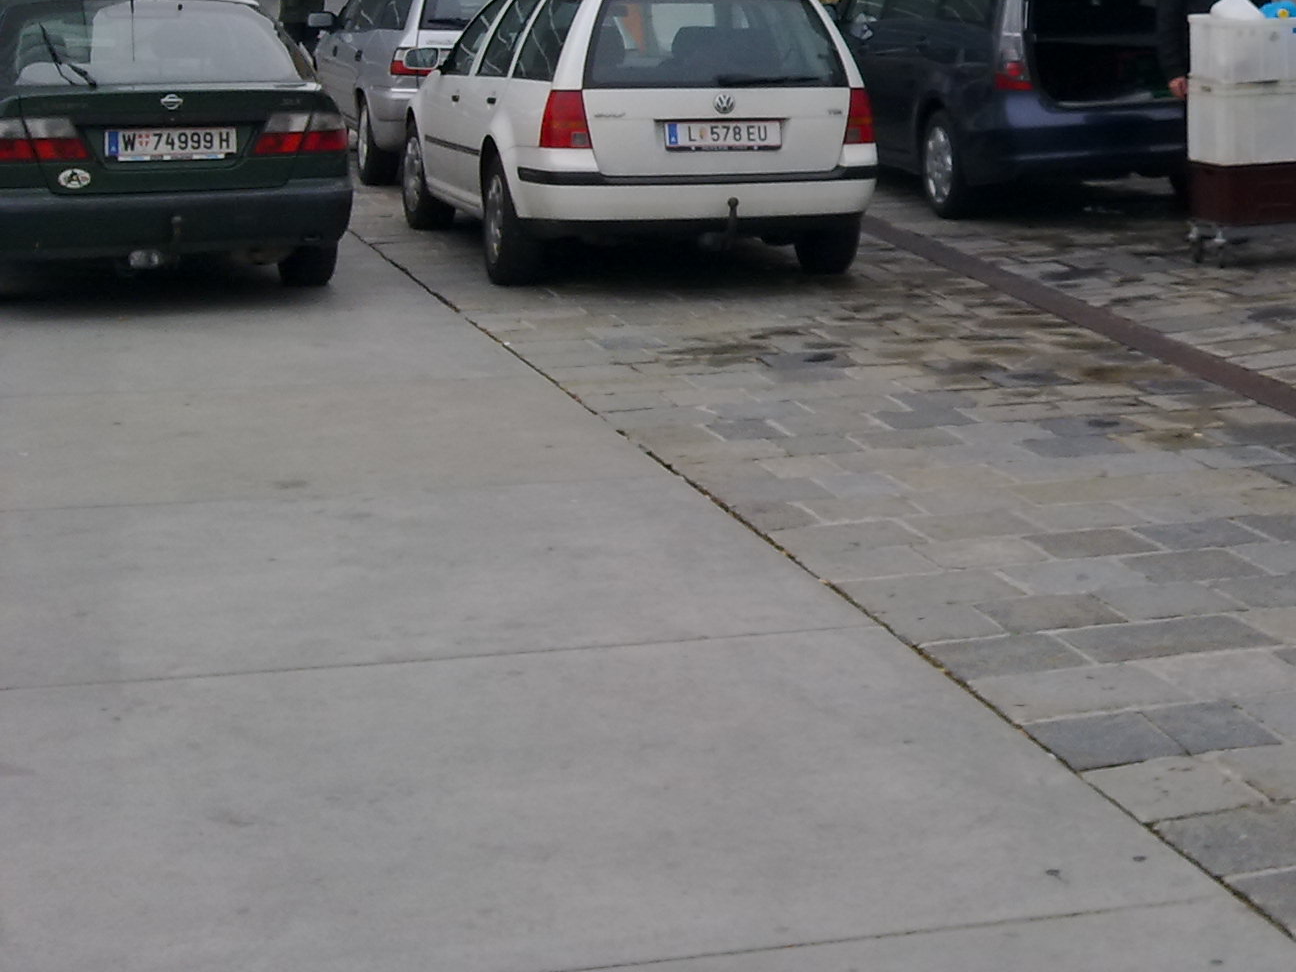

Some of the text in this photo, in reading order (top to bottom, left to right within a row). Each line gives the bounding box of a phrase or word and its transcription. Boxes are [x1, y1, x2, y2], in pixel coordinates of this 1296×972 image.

[121, 131, 231, 151] W 74999 H
[688, 125, 768, 142] L 578 EU
